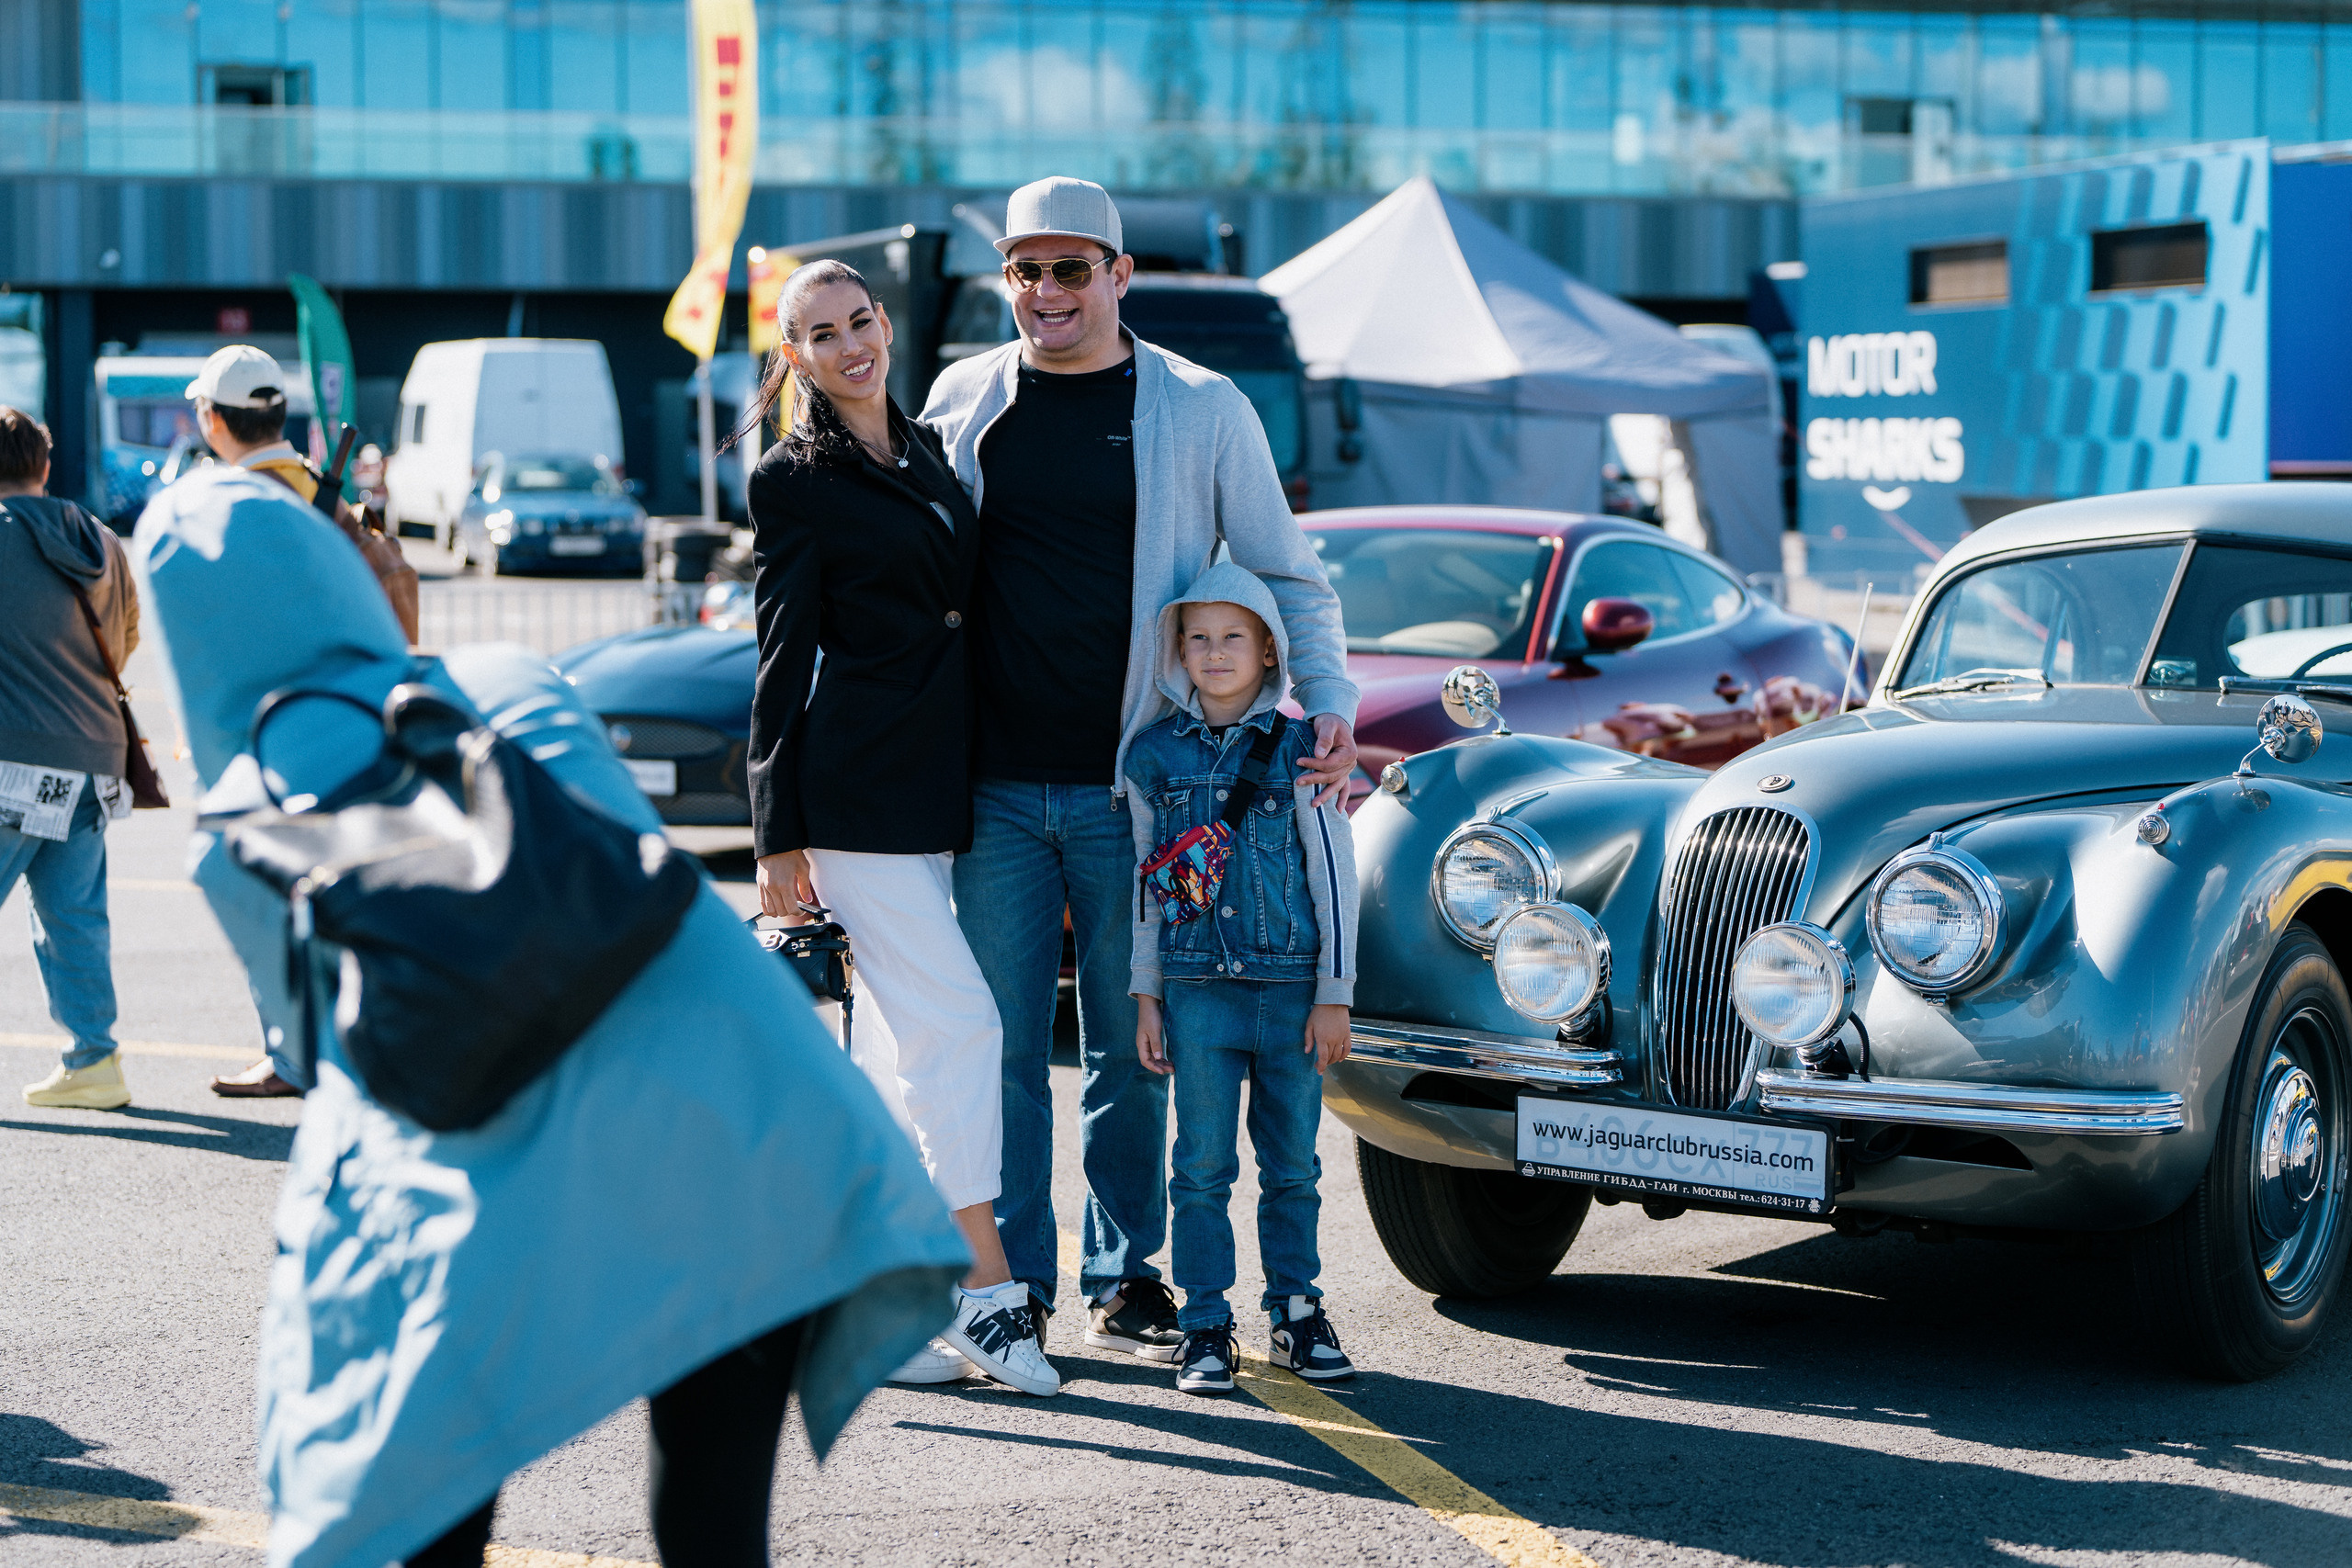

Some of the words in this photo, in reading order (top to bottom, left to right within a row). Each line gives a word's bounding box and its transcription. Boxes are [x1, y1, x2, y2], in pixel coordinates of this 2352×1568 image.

[1807, 331, 1938, 398] MOTOR
[1806, 417, 1964, 483] SHARKS
[1532, 1122, 1814, 1172] www.jaguarclubrussia.com
[1536, 1166, 1600, 1182] УПРАВЛЕНИЕ
[1603, 1174, 1678, 1192] ГИБДД-ГАИ
[1692, 1186, 1737, 1200] МОСКВЫ
[1756, 1173, 1792, 1190] RUS
